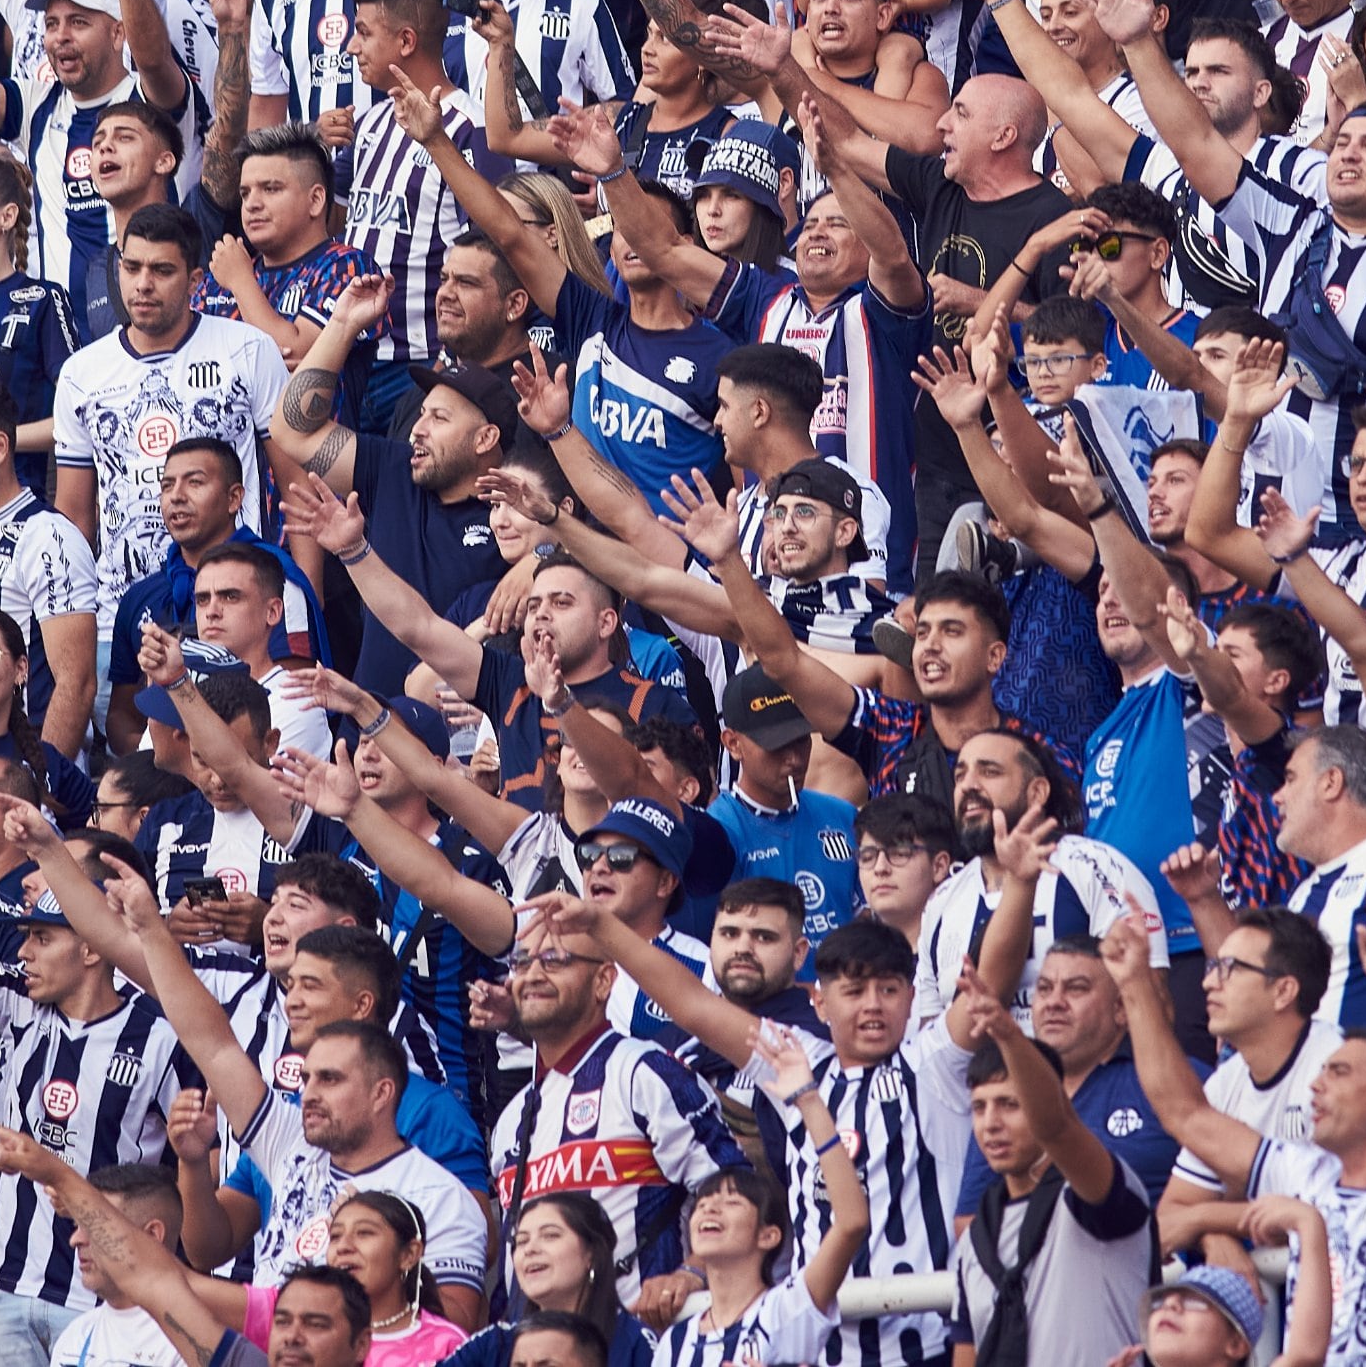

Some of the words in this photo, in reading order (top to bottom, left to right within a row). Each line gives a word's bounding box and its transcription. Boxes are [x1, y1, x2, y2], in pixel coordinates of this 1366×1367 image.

[182, 19, 202, 83] Chevalli
[312, 53, 352, 73] ICBC
[312, 74, 352, 86] Argentina
[612, 800, 675, 837] TALLERES
[35, 1119, 77, 1148] ICBC
